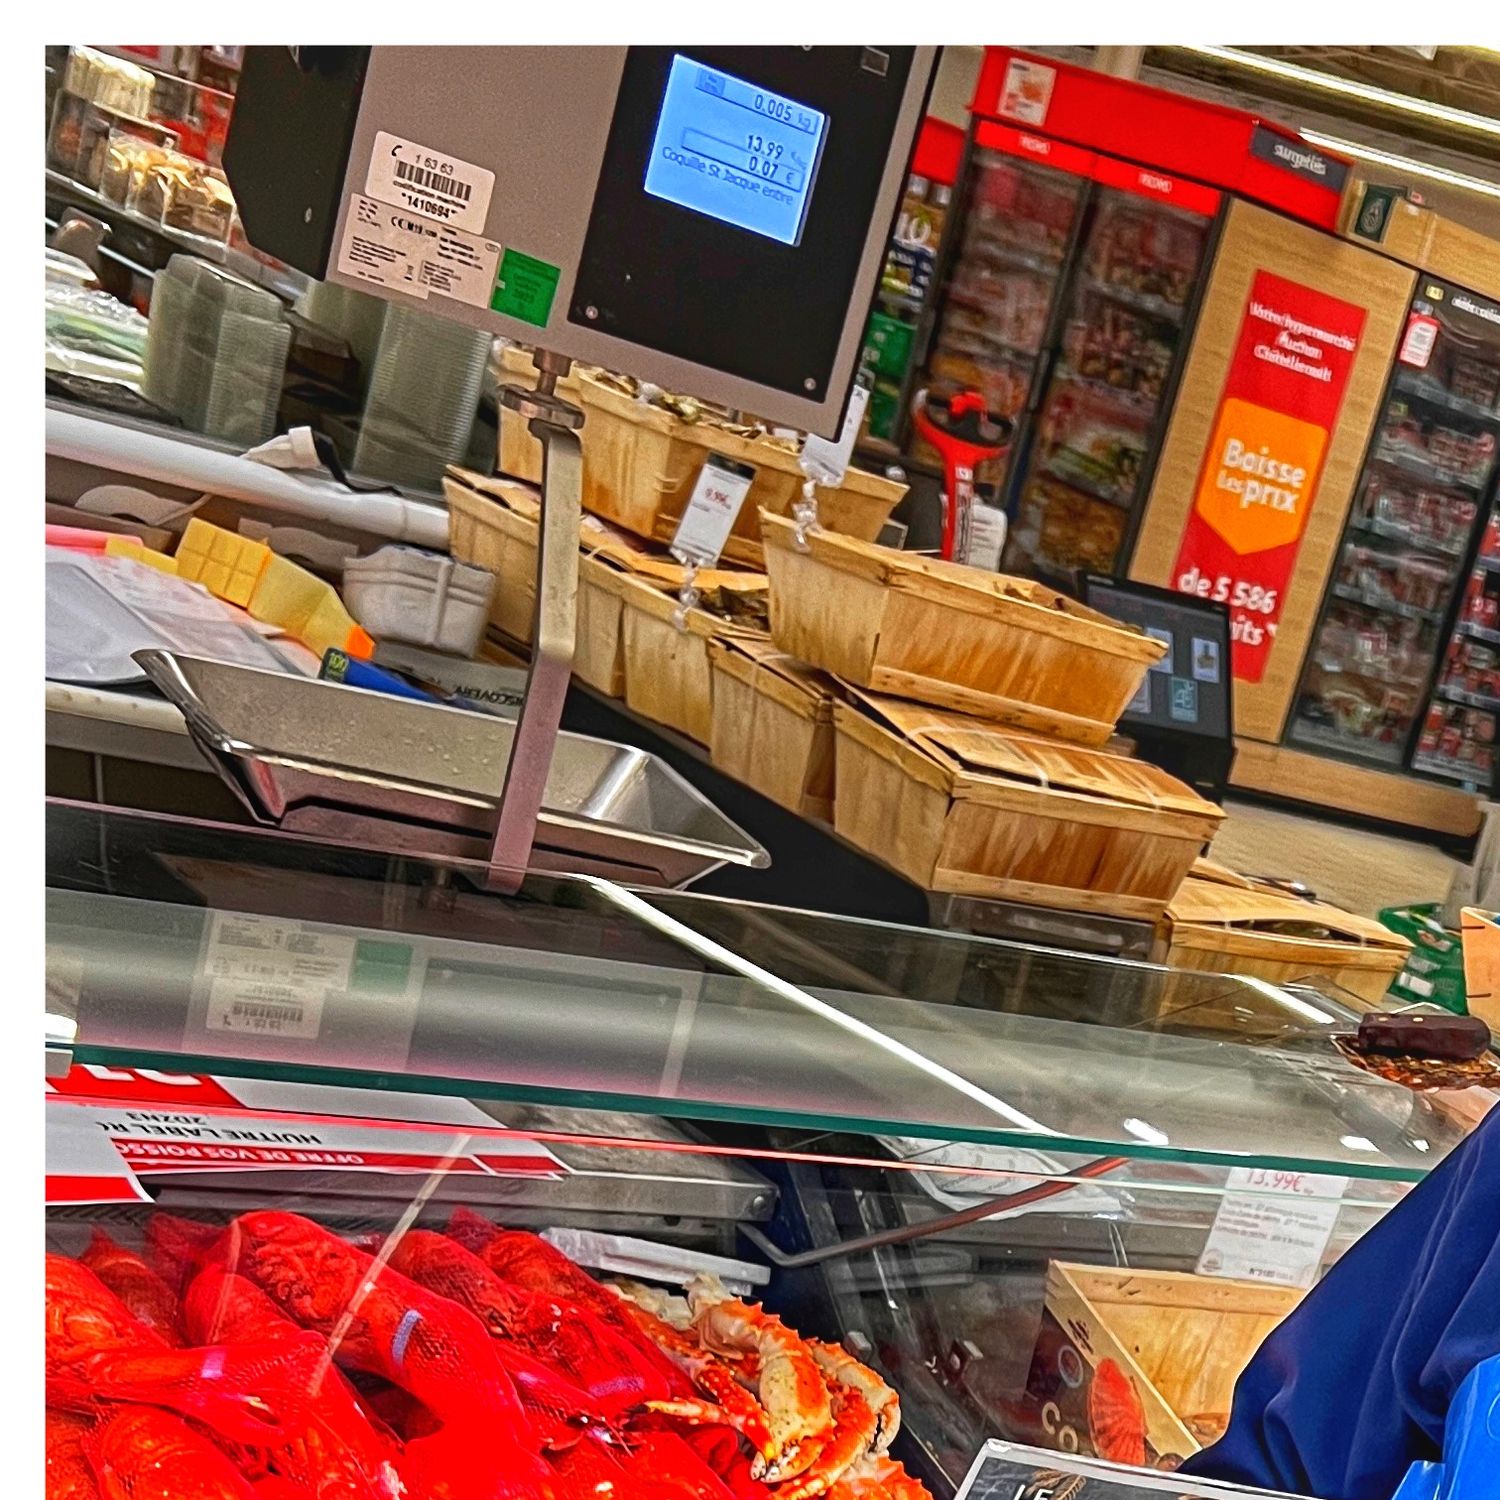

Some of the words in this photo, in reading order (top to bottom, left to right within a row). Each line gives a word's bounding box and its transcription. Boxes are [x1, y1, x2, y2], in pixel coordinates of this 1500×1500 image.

[755, 94, 793, 122] 0.005
[748, 134, 784, 160] 13.99
[424, 156, 438, 171] 63
[440, 163, 454, 176] 63
[749, 156, 779, 180] 0.07
[1223, 438, 1306, 488] Baisse
[1240, 479, 1300, 514] prix
[1178, 567, 1212, 598] de
[1212, 576, 1232, 603] 5
[1231, 581, 1278, 615] 586
[130, 1122, 221, 1141] LABEL
[221, 1128, 322, 1146] HUITRE
[205, 1146, 258, 1160] VOS
[259, 1149, 291, 1162] DE
[291, 1151, 365, 1165] OFFRE
